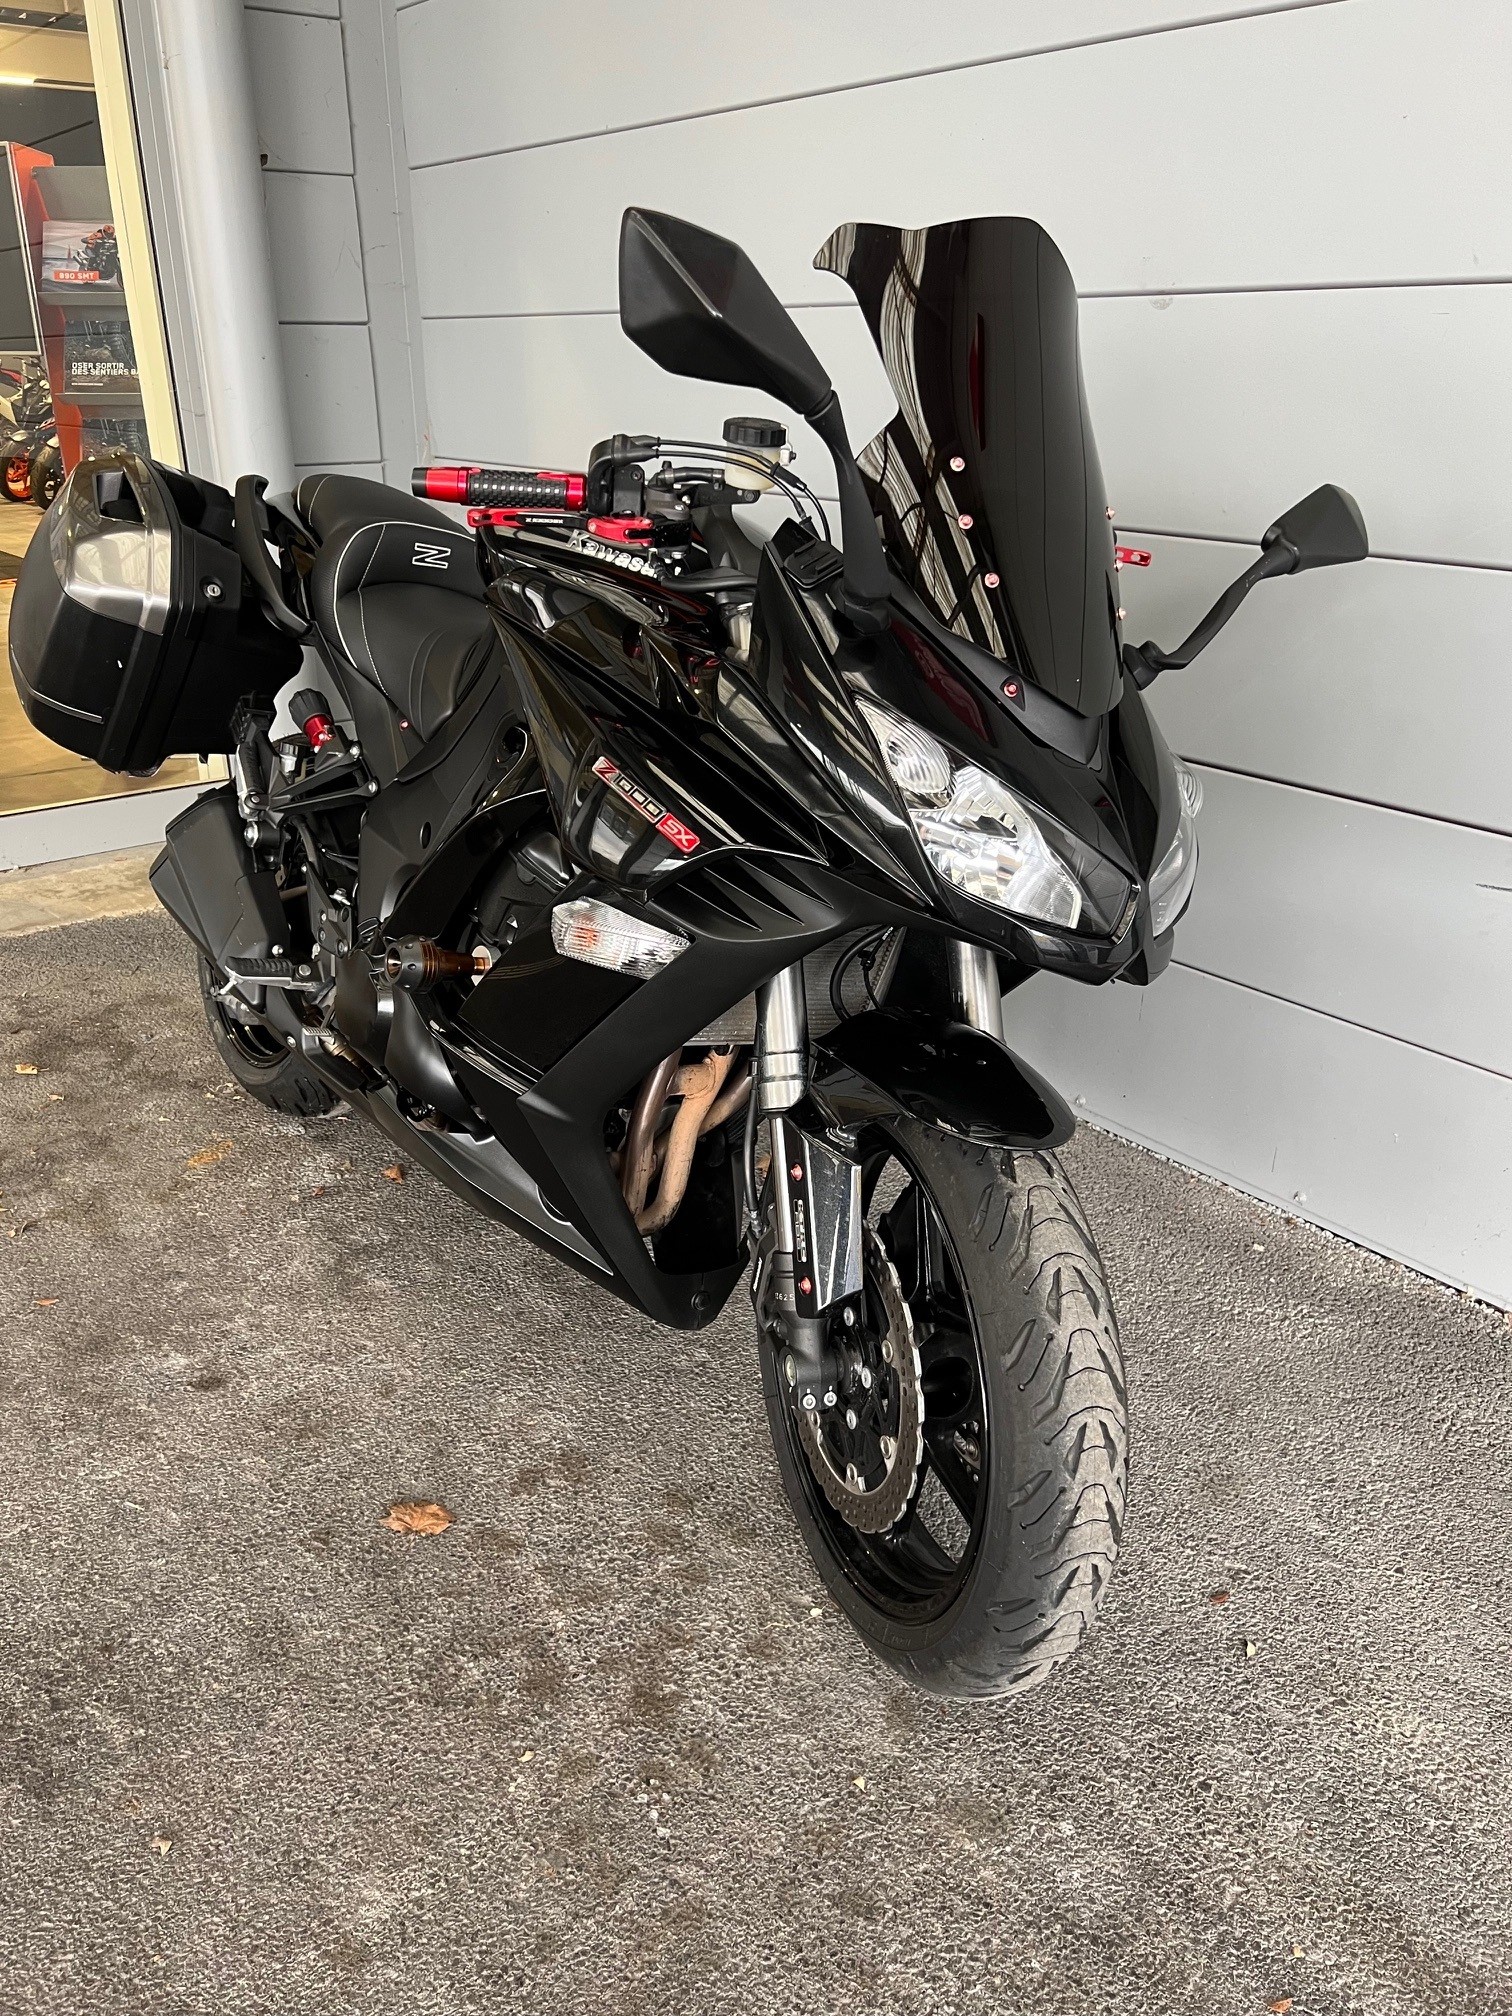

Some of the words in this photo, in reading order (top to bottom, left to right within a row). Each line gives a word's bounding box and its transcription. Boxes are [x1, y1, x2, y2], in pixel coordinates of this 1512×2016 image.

[59, 272, 75, 280] 890
[77, 272, 95, 280] SMT
[95, 362, 125, 370] SORTIR
[90, 368, 129, 376] SENTIERS
[660, 817, 696, 848] SX
